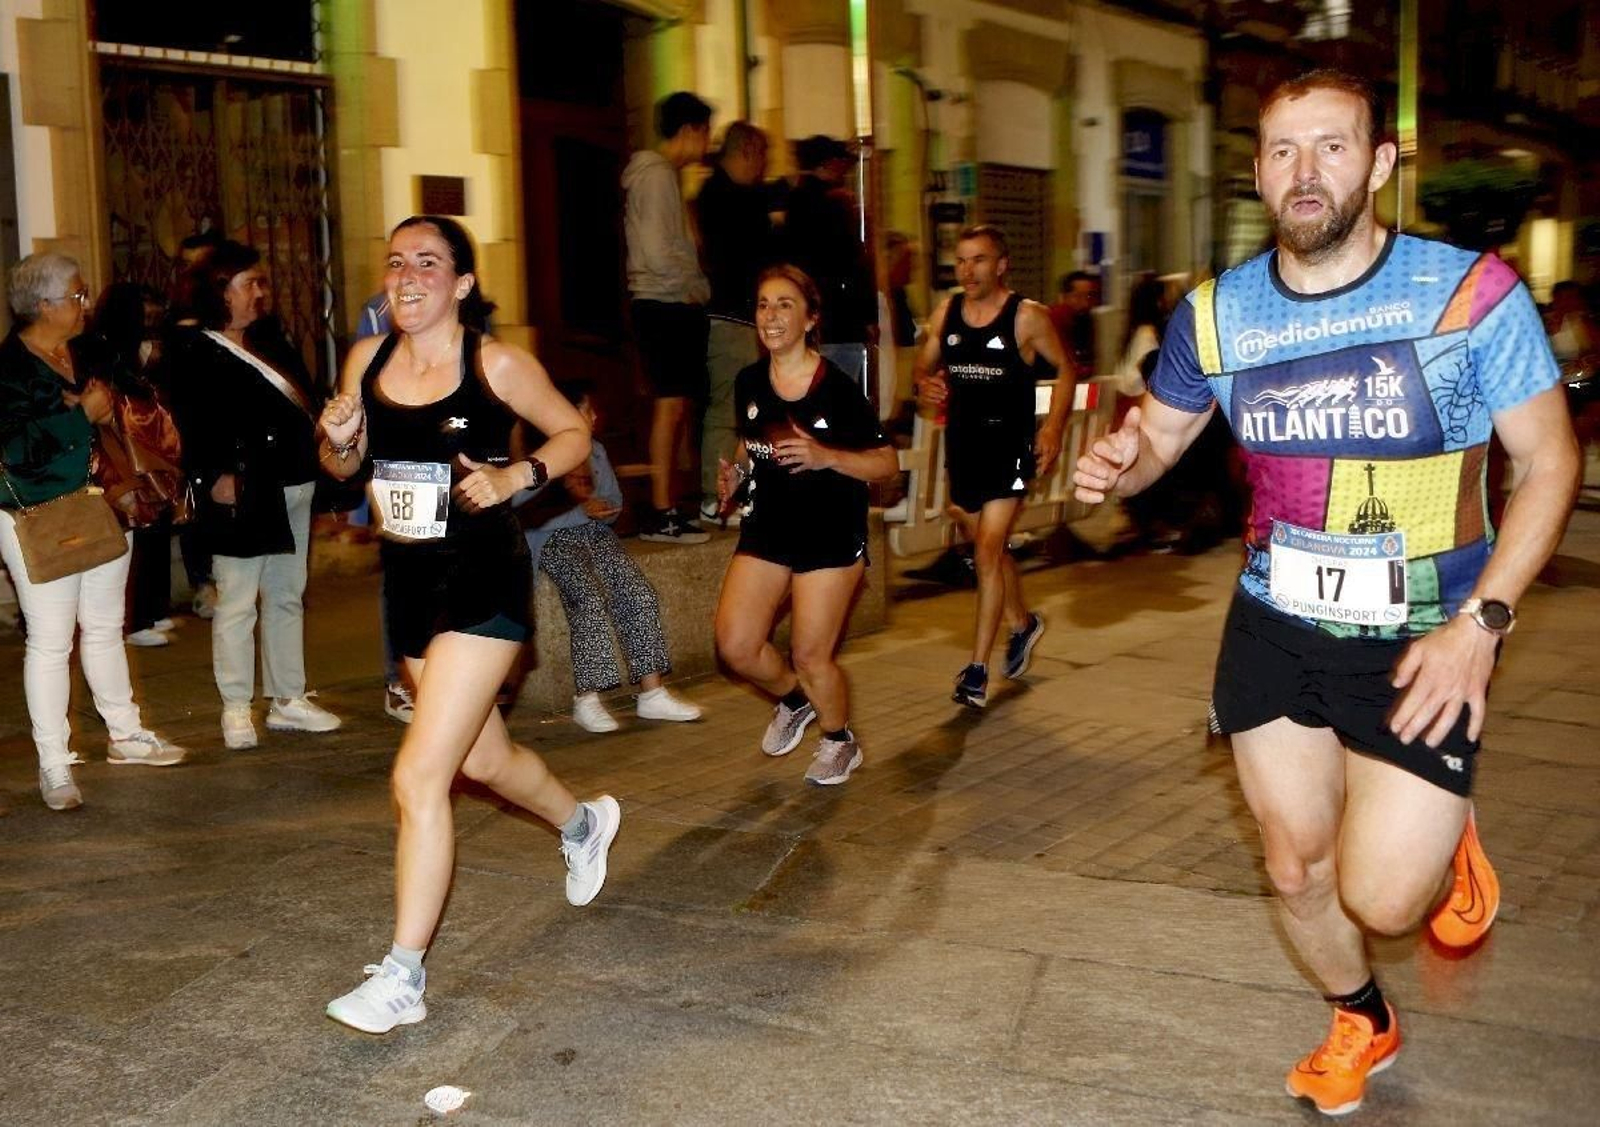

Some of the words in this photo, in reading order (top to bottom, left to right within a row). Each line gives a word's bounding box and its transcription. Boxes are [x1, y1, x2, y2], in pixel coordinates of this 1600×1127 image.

[1369, 301, 1411, 314] BANCO
[1239, 308, 1414, 358] mediolanum
[1364, 374, 1405, 398] 15K
[390, 491, 414, 521] 68
[1334, 537, 1378, 545] NOCTURNA
[1348, 547, 1378, 556] 2024
[1316, 566, 1346, 602] 17
[1292, 600, 1378, 622] PUNGINSPORT
